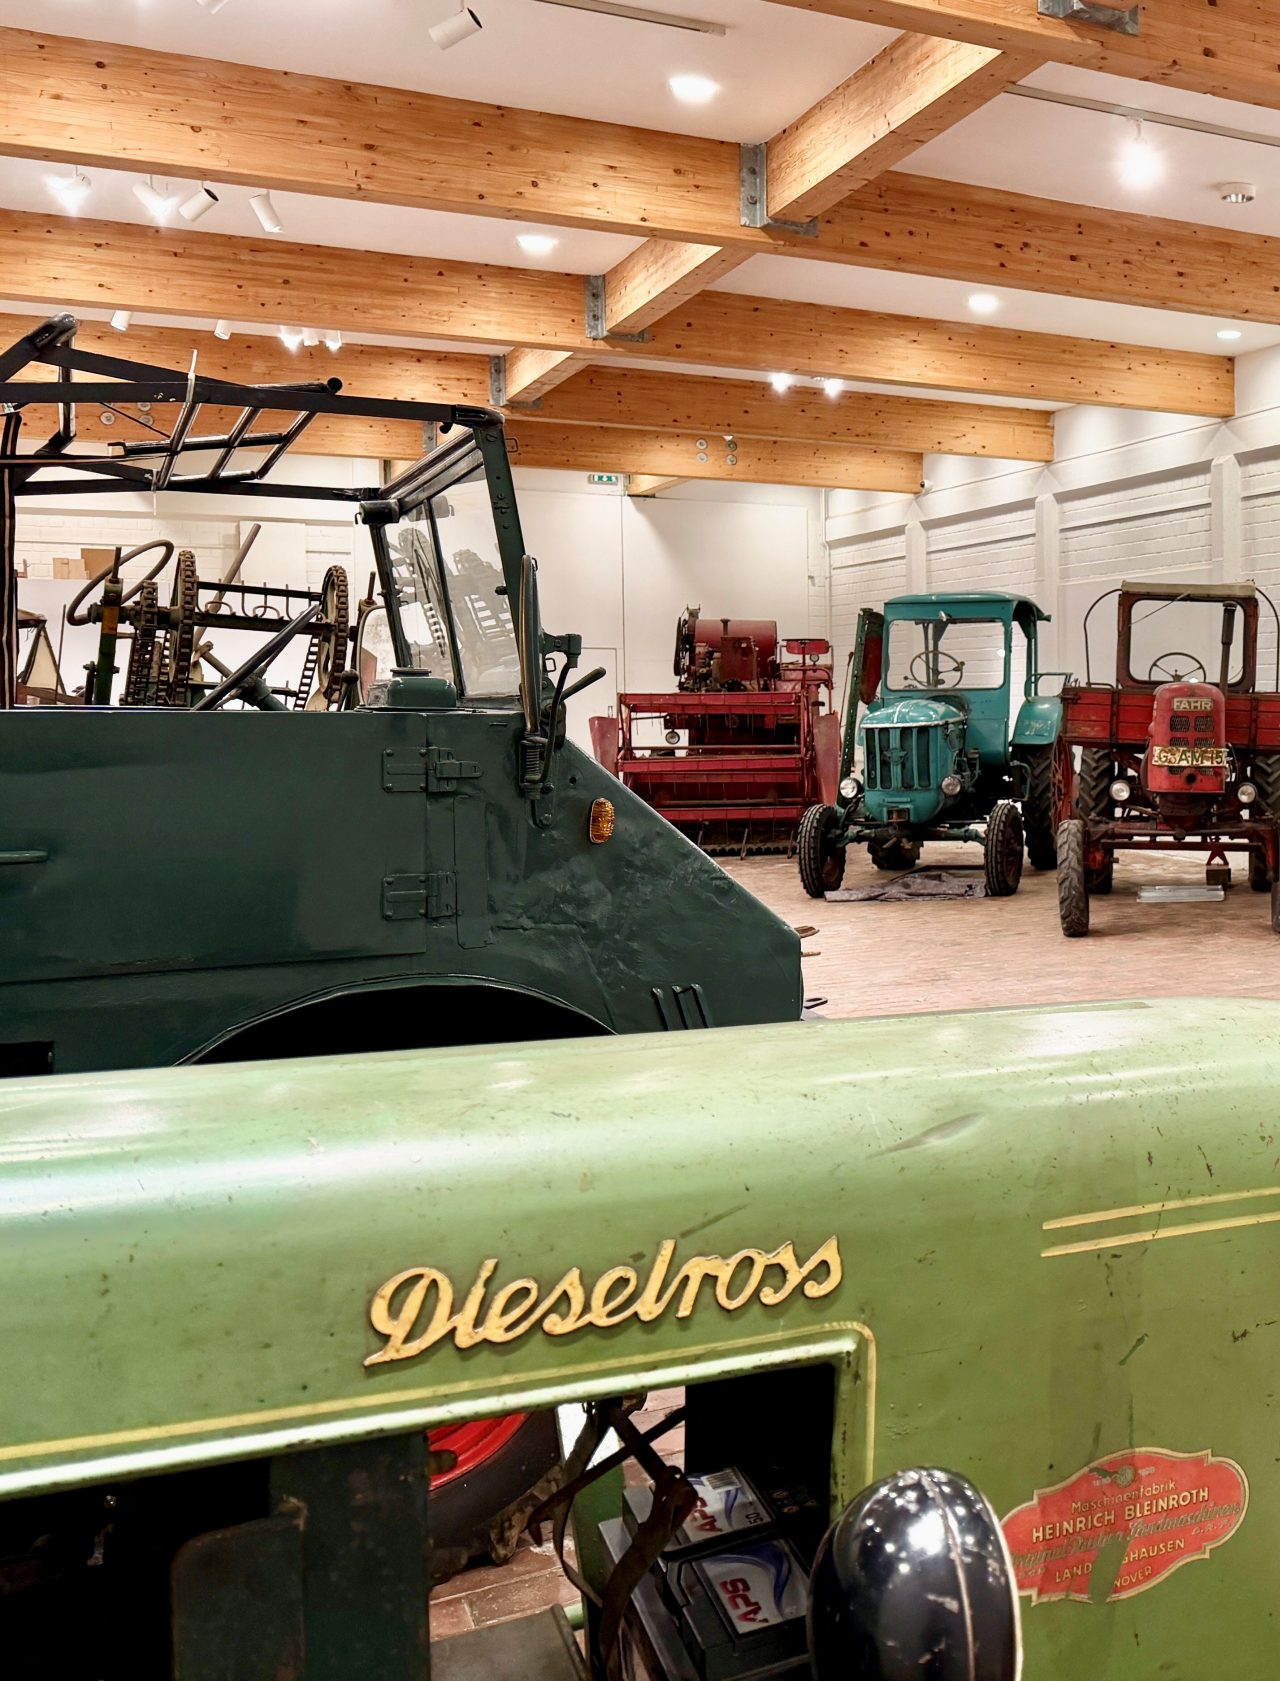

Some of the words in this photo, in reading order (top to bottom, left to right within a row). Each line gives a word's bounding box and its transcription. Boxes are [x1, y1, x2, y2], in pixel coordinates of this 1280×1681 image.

[1174, 698, 1213, 711] FAHR
[362, 1234, 844, 1367] Dieselross
[1032, 1510, 1115, 1543] HEINRICH
[1124, 1487, 1209, 1521] BLEINROTH
[1071, 1479, 1177, 1514] Maschinenfabrik
